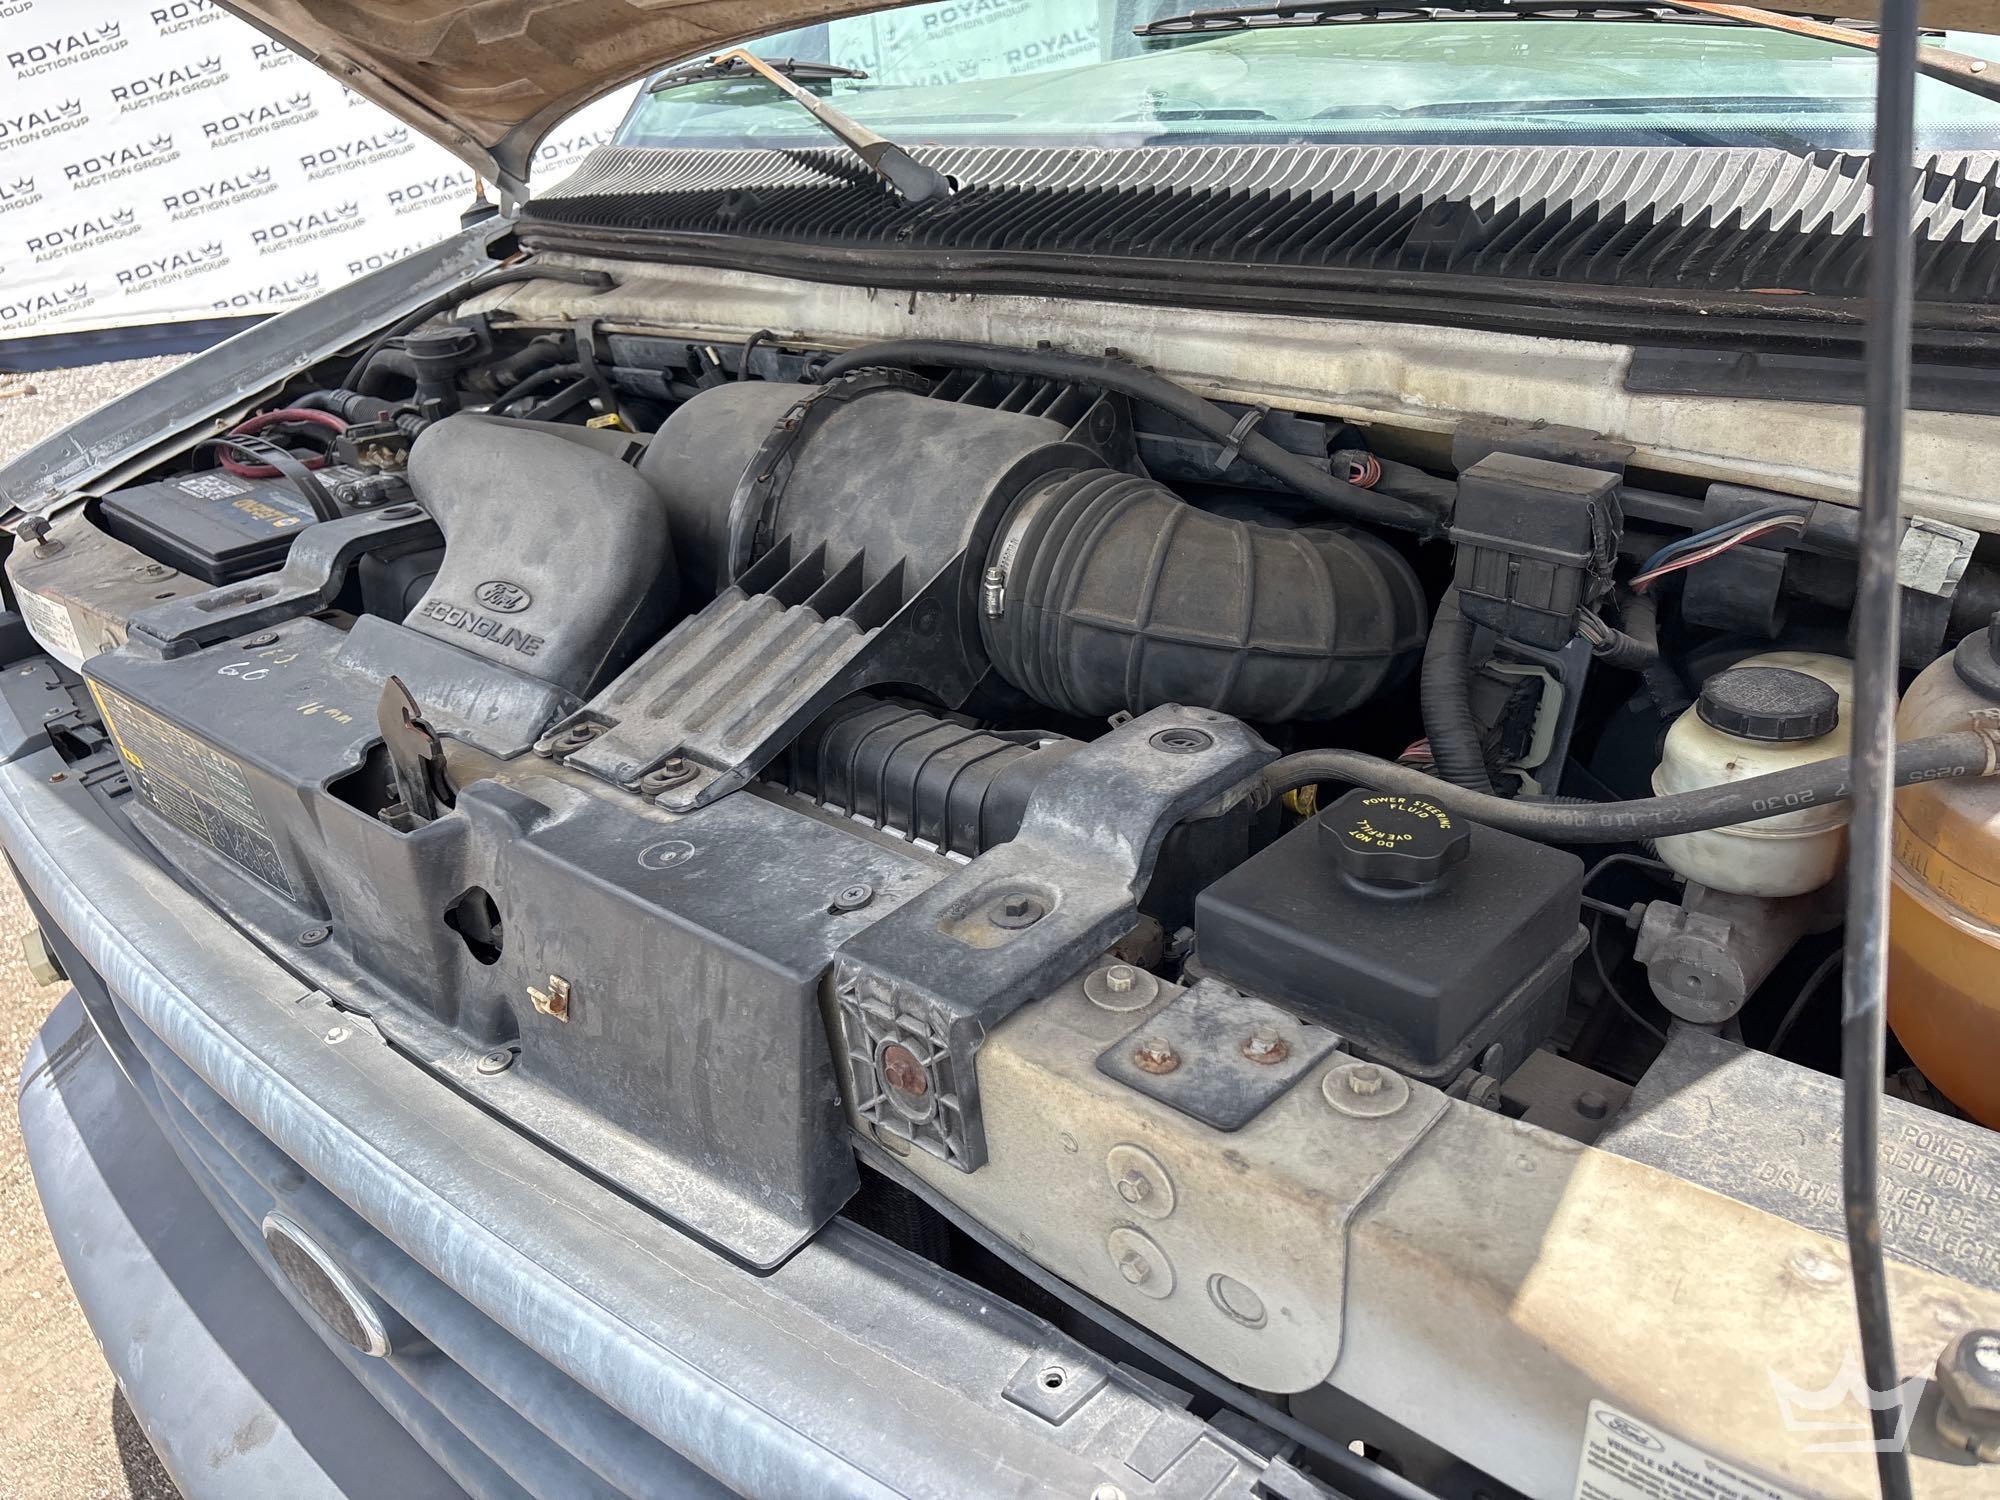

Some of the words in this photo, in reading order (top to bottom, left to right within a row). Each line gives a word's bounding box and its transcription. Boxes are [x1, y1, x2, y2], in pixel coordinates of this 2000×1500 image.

[159, 12, 221, 37] AUCTION
[7, 31, 100, 69] ROYAL
[17, 54, 79, 80] AUCTION
[80, 39, 128, 61] GROUP
[1006, 30, 1087, 65] ROYAL
[111, 65, 200, 102] ROYAL
[120, 88, 180, 115] AUCTION
[181, 73, 230, 97] GROUP
[41, 115, 90, 138] GROUP
[203, 102, 291, 138] ROYAL
[211, 124, 270, 150] AUCTION
[271, 109, 319, 131] GROUP
[64, 144, 152, 180] ROYAL
[73, 166, 132, 191] AUCTION
[133, 150, 181, 173] GROUP
[300, 135, 388, 171] ROYAL
[307, 156, 366, 182] AUCTION
[367, 142, 416, 165] GROUP
[163, 176, 250, 212] ROYAL
[171, 198, 230, 223] AUCTION
[231, 182, 279, 205] GROUP
[388, 171, 472, 206] ROYAL
[395, 191, 454, 216] AUCTION
[26, 217, 114, 252] ROYAL
[35, 238, 94, 263] AUCTION
[95, 224, 142, 245] GROUP
[252, 209, 338, 246] ROYAL
[259, 231, 318, 257] AUCTION
[319, 216, 366, 239] GROUP
[116, 249, 202, 286] ROYAL
[124, 272, 183, 296] AUCTION
[184, 256, 231, 279] GROUP
[482, 583, 524, 609] Ford
[420, 598, 546, 657] ECONOLINE
[1362, 797, 1406, 806] POWER
[1412, 800, 1451, 829] STEERING
[1390, 803, 1429, 819] FLUID
[1751, 789, 1815, 812] 2030
[1348, 829, 1373, 843] NOT
[1356, 819, 1413, 841] OVERFILL
[1376, 840, 1394, 848] DO
[1899, 1125, 1978, 1167] POWER
